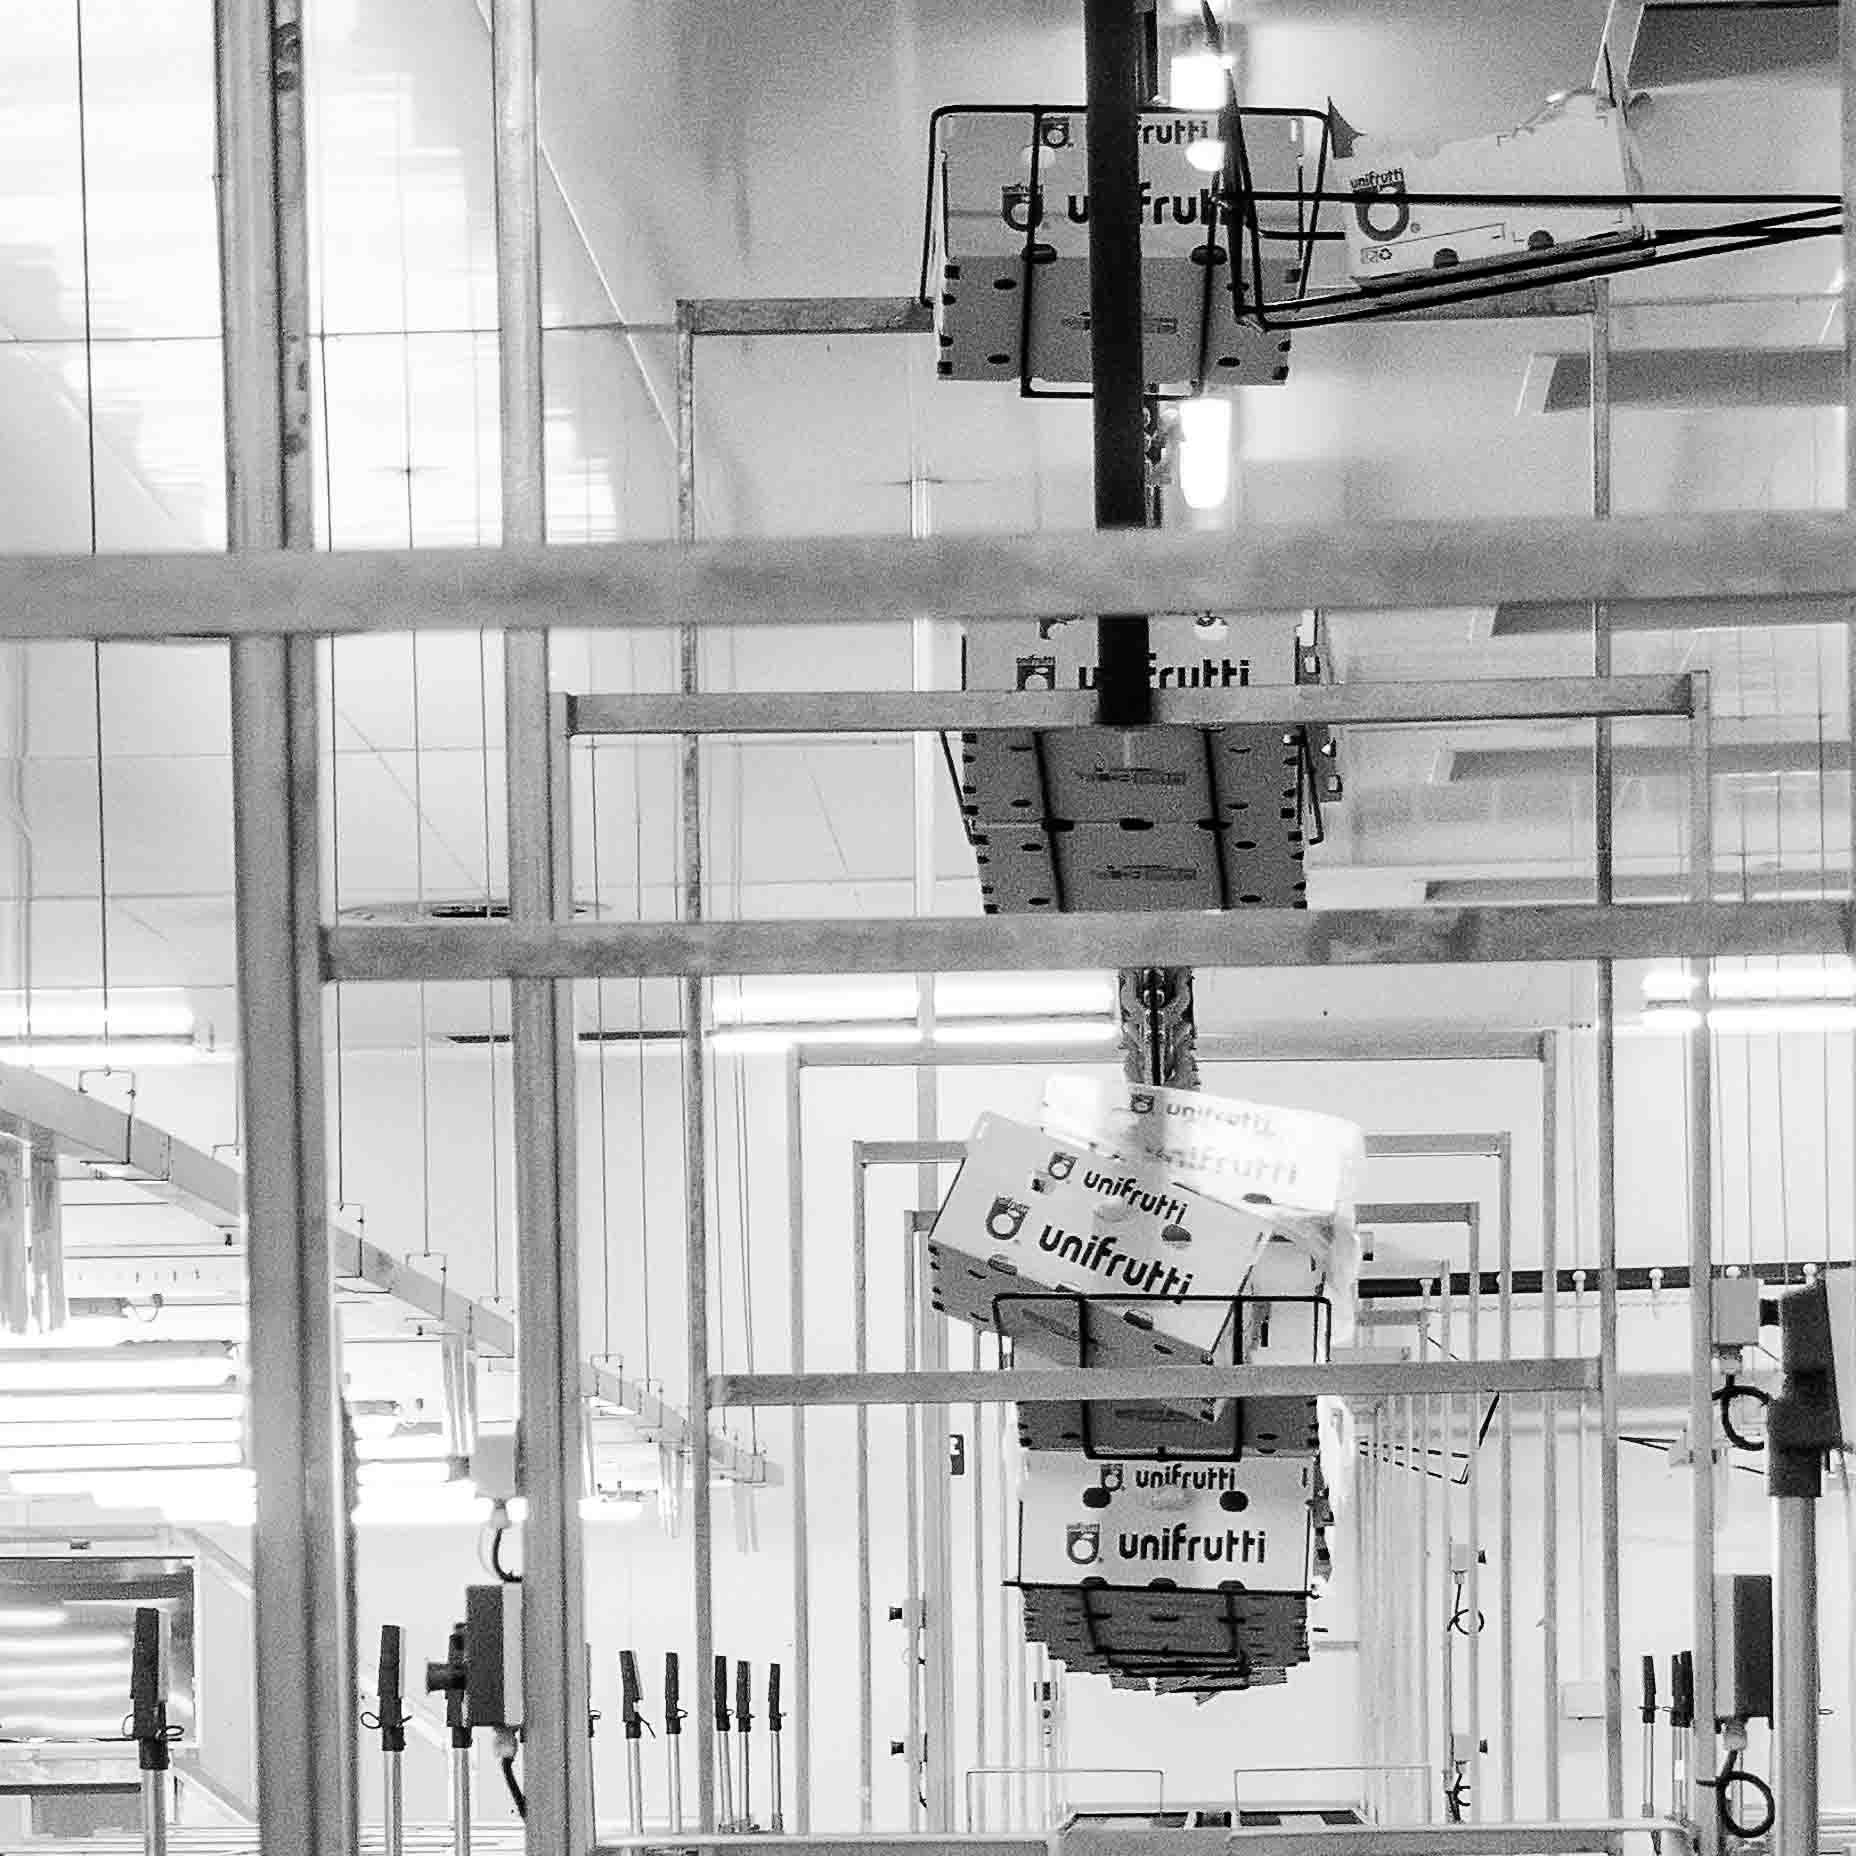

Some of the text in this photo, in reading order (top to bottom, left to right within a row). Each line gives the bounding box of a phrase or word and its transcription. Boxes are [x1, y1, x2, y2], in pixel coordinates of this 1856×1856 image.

[1084, 1170, 1188, 1224] unifrutti
[1039, 1225, 1193, 1304] unifrutti
[1136, 1463, 1235, 1490] unifrutti
[1119, 1523, 1265, 1563] unifrutti
